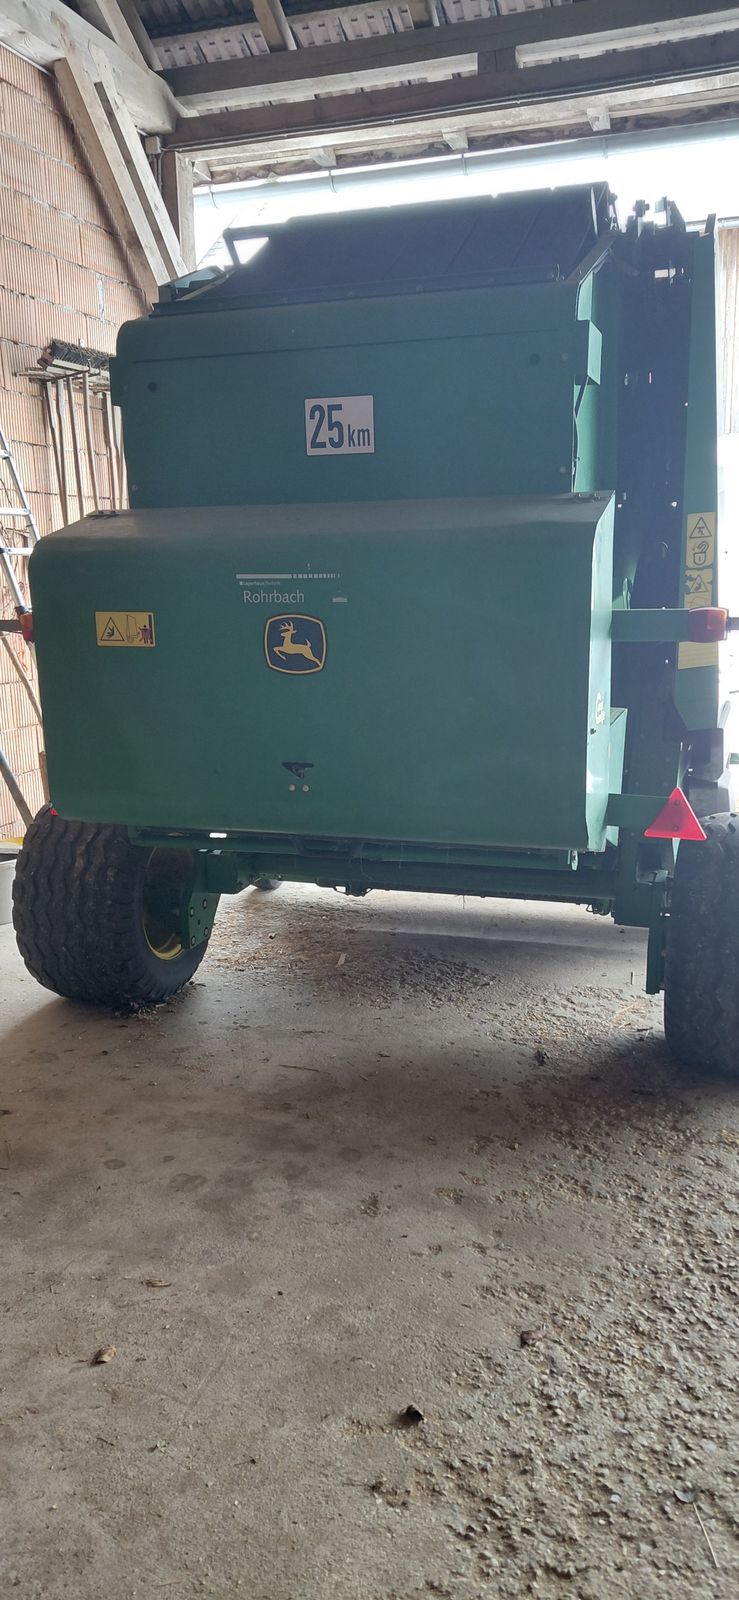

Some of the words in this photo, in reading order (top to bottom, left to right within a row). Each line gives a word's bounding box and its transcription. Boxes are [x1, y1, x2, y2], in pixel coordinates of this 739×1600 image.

[309, 404, 344, 449] 25
[347, 423, 371, 448] km
[243, 589, 305, 604] Rohrbach
